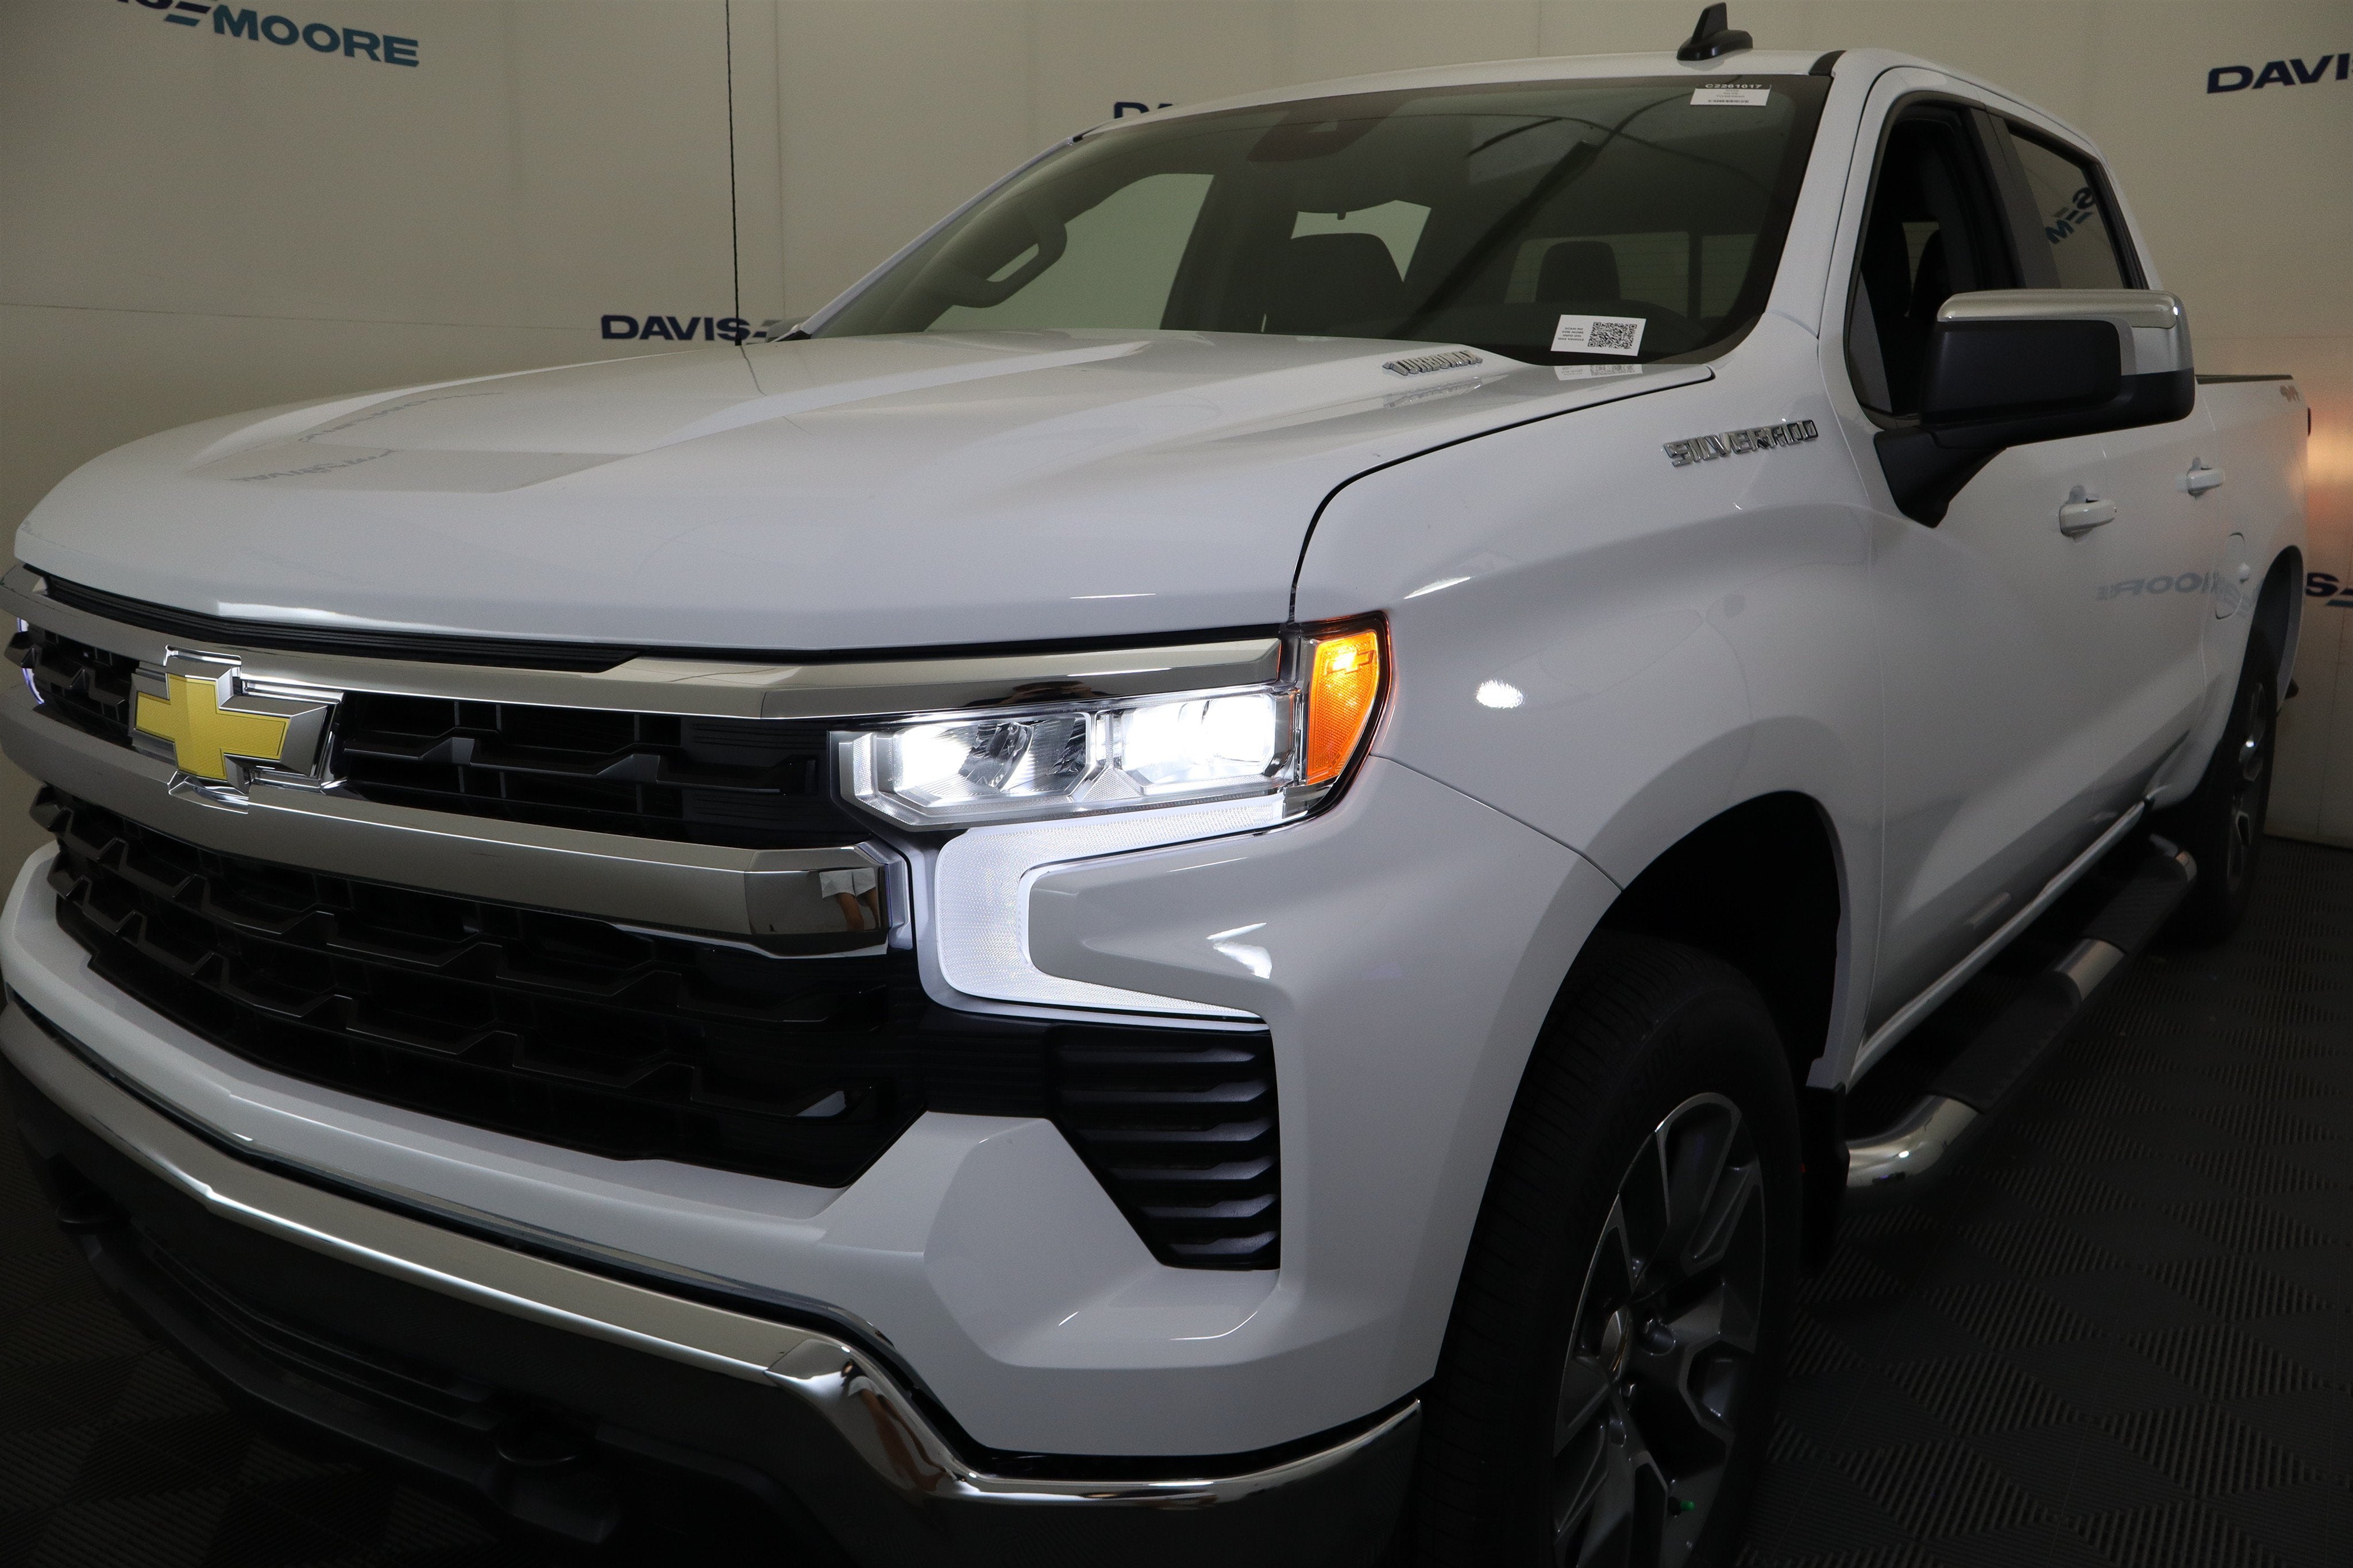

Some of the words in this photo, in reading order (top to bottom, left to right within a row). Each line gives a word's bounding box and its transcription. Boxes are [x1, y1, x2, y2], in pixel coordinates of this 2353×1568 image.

[213, 5, 420, 67] MOORE
[2207, 53, 2353, 94] DAVI
[601, 315, 751, 341] DAVIS
[1382, 350, 1483, 376] TURBOMAX
[1664, 419, 1819, 467] SILVERADO
